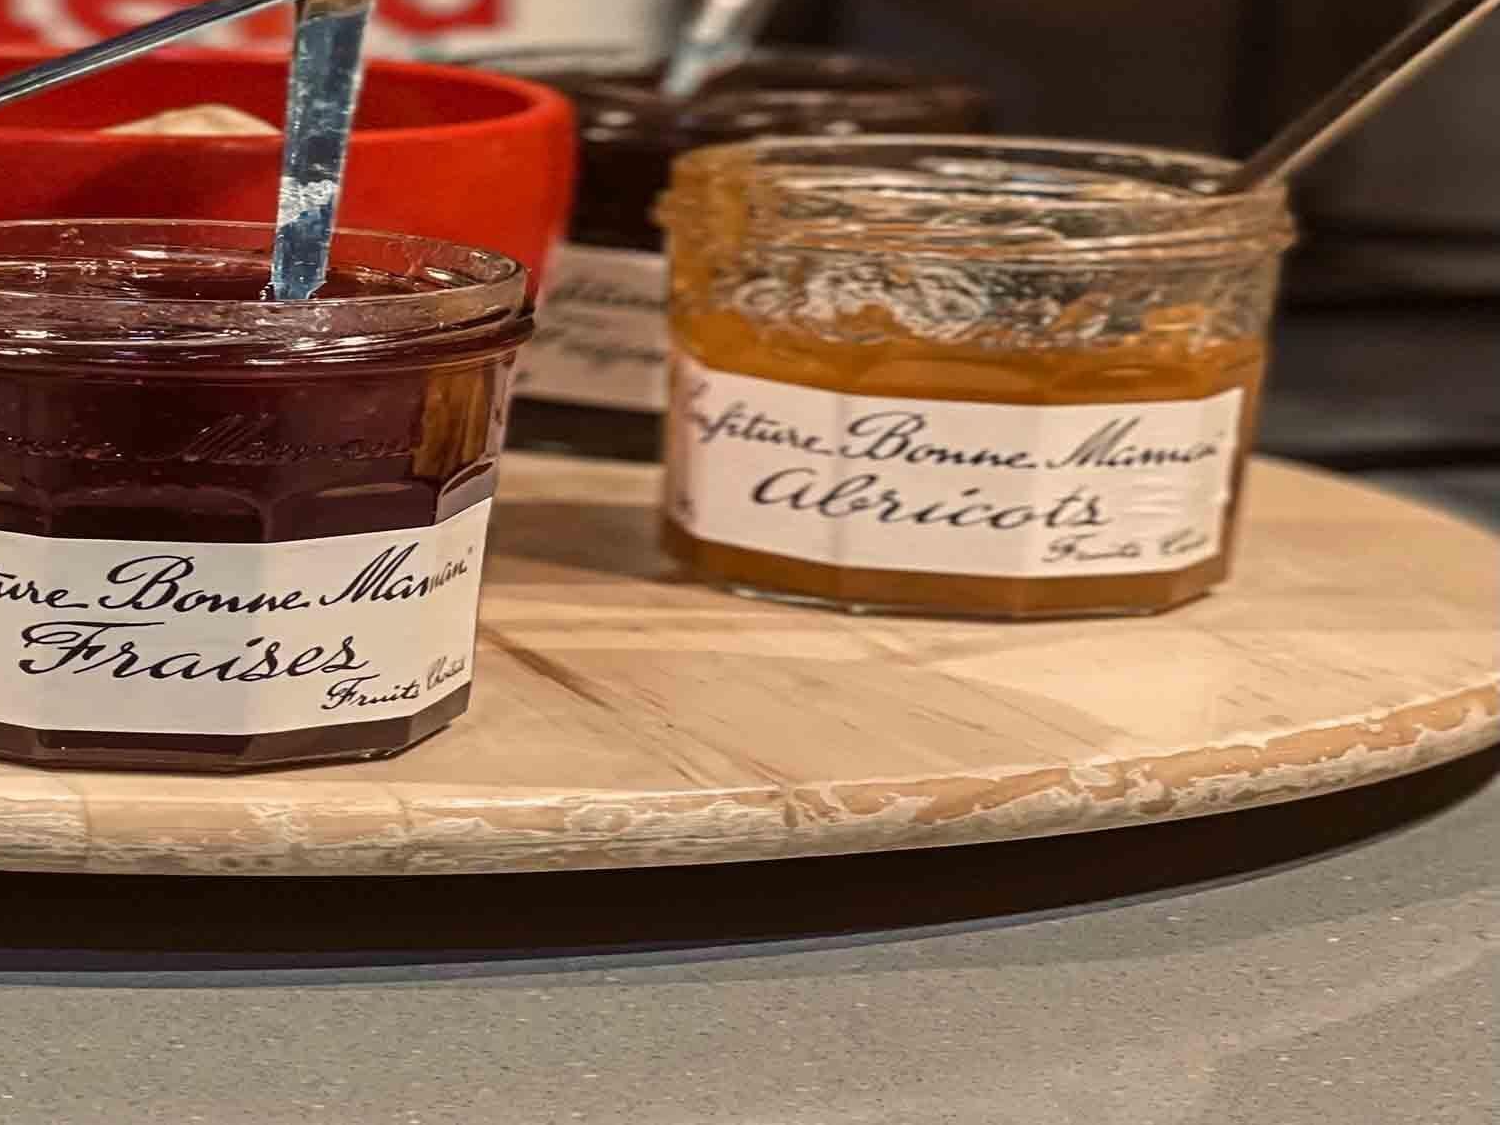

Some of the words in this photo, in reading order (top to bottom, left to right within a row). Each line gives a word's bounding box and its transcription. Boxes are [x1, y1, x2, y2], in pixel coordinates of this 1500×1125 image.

[837, 411, 1037, 469] Bonne
[749, 466, 1113, 530] Abricots
[99, 554, 311, 613] Bonne
[17, 619, 369, 684] Fraises
[320, 673, 421, 710] Fruits
